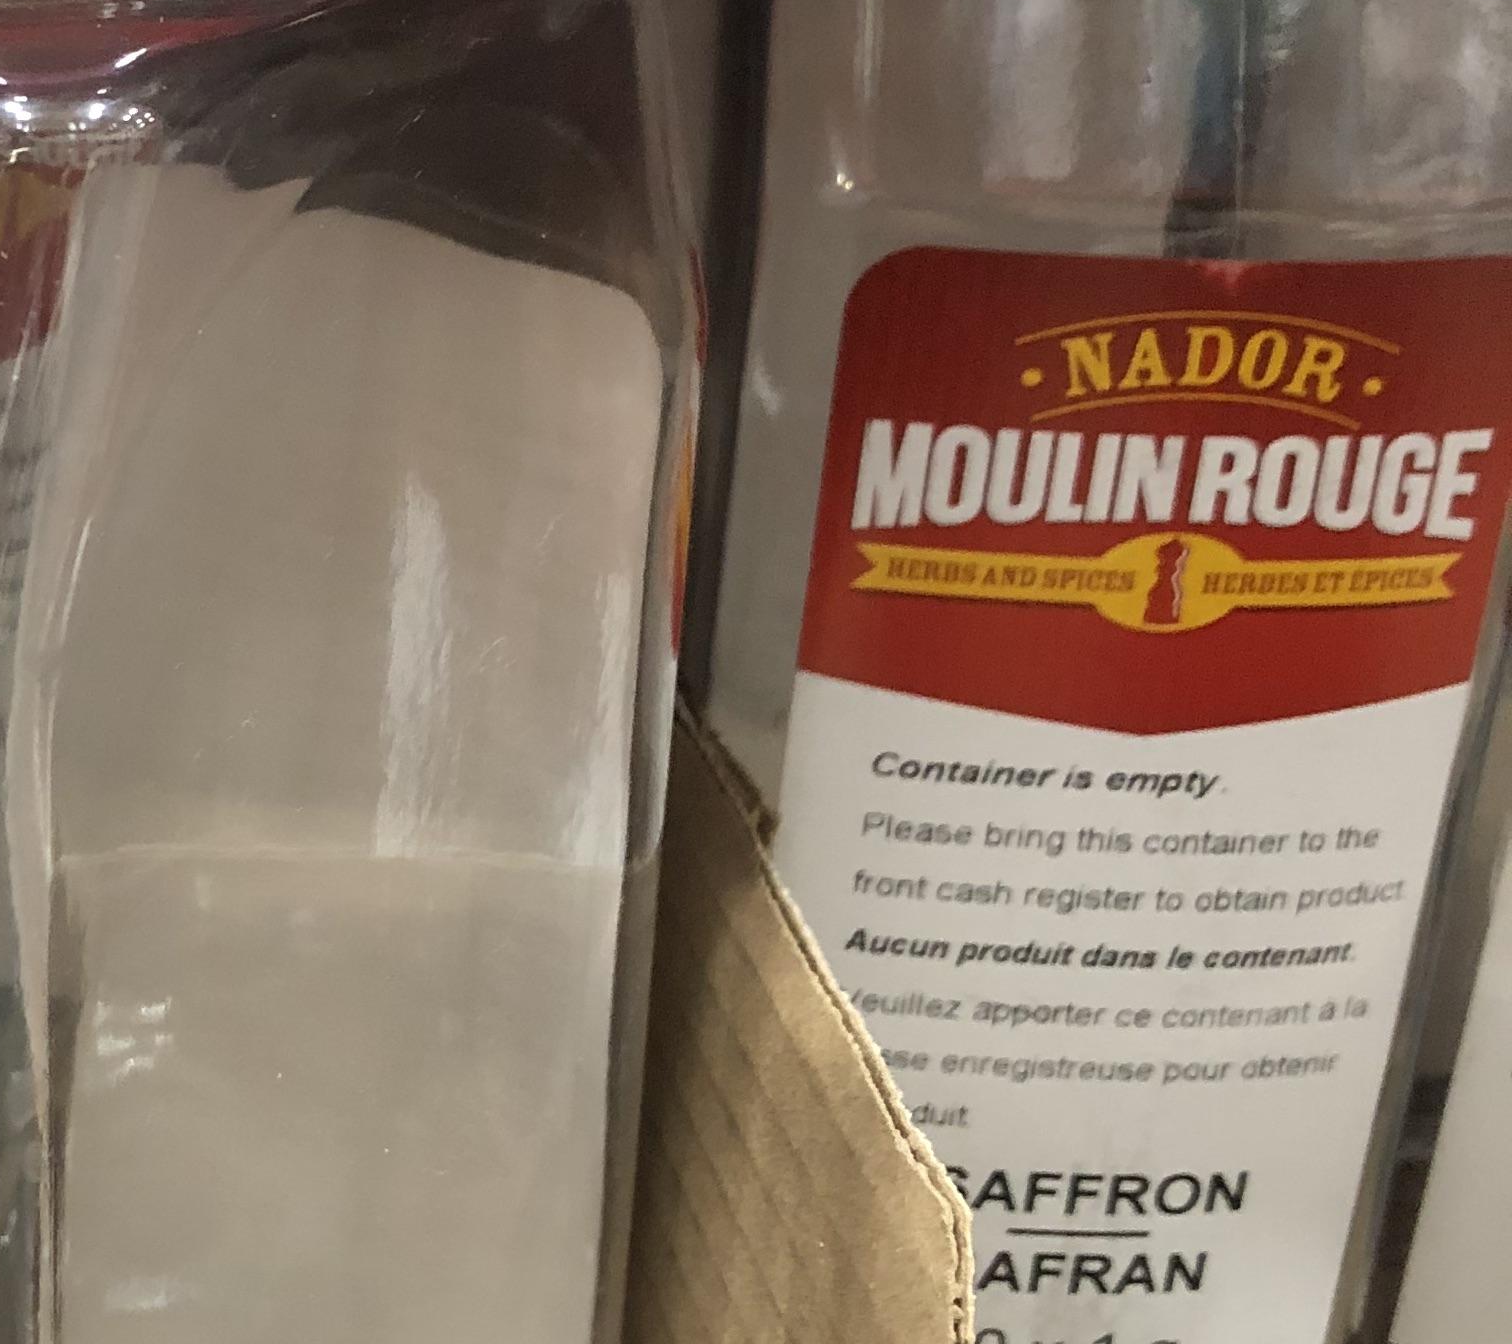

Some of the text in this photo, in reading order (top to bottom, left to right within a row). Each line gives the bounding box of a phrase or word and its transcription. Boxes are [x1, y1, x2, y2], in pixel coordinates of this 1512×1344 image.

[1060, 326, 1348, 404] NADOR
[851, 419, 1495, 540] MOULIN ROUGE
[887, 557, 1136, 593] HERBS AND SPICES
[1202, 572, 1308, 594] HERBES
[1313, 571, 1344, 593] ET
[872, 752, 1057, 788] Container
[1062, 767, 1094, 790] is
[862, 812, 1381, 858] Please bring this container to the
[853, 869, 928, 900] front
[936, 880, 1013, 905] cash
[1024, 887, 1146, 915] register
[1155, 888, 1185, 912] to
[1195, 887, 1288, 913] obtain
[844, 928, 950, 959] Aucun
[956, 941, 1075, 967] produit
[1081, 943, 1157, 969] dans
[1165, 946, 1195, 970] le
[972, 1001, 1107, 1028] apporter
[1114, 1008, 1154, 1028] ce
[1161, 1001, 1311, 1028] contenant
[1344, 996, 1370, 1019] la
[941, 1054, 1156, 1083] enregistreuse
[1162, 1062, 1232, 1085] pour
[1241, 1054, 1338, 1080] obtenir
[978, 1250, 1207, 1294] AFRAN
